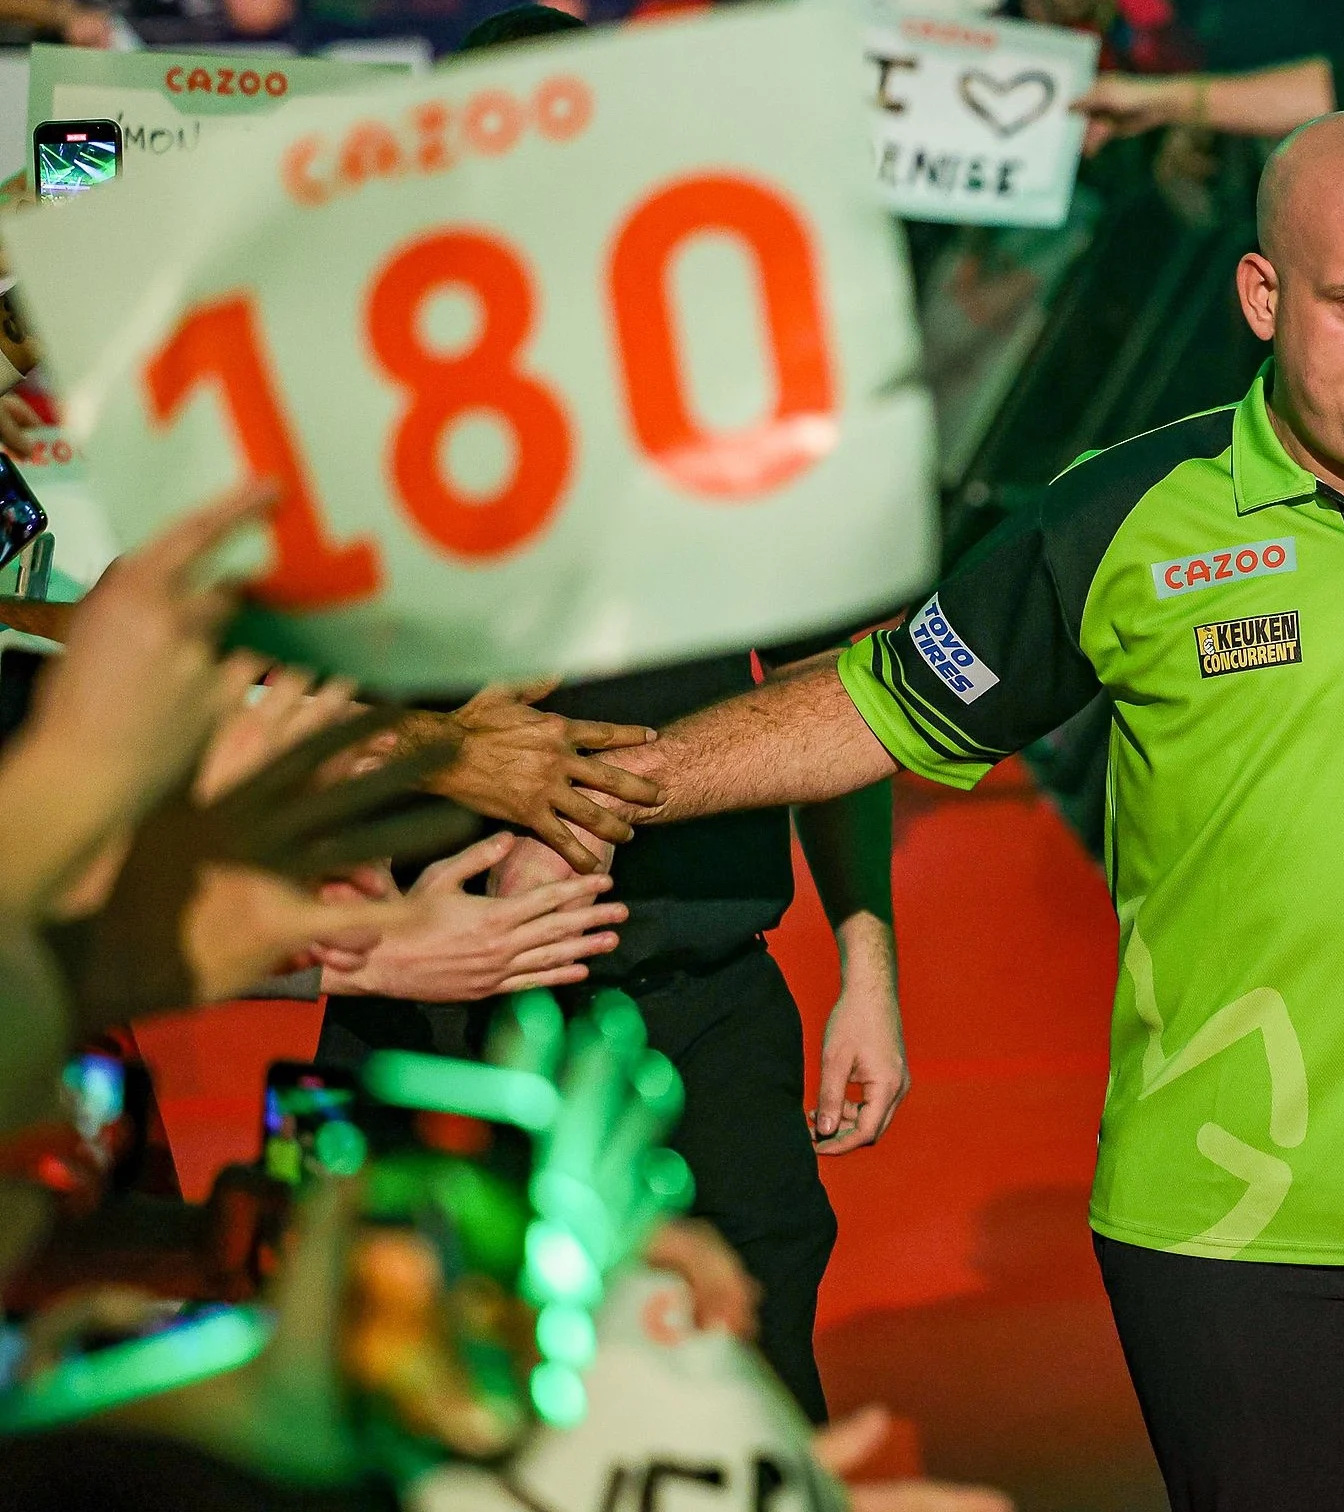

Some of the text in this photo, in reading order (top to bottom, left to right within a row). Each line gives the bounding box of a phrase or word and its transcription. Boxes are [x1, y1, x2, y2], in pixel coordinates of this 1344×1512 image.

[165, 66, 289, 97] CAZOO
[280, 73, 597, 207] CAZOO
[144, 168, 838, 609] 180
[1164, 544, 1286, 590] CAZOO
[913, 622, 975, 693] TIRES
[924, 601, 975, 667] TOYO
[1203, 641, 1297, 674] CONCURRENT
[1216, 614, 1296, 651] KEUKEN
